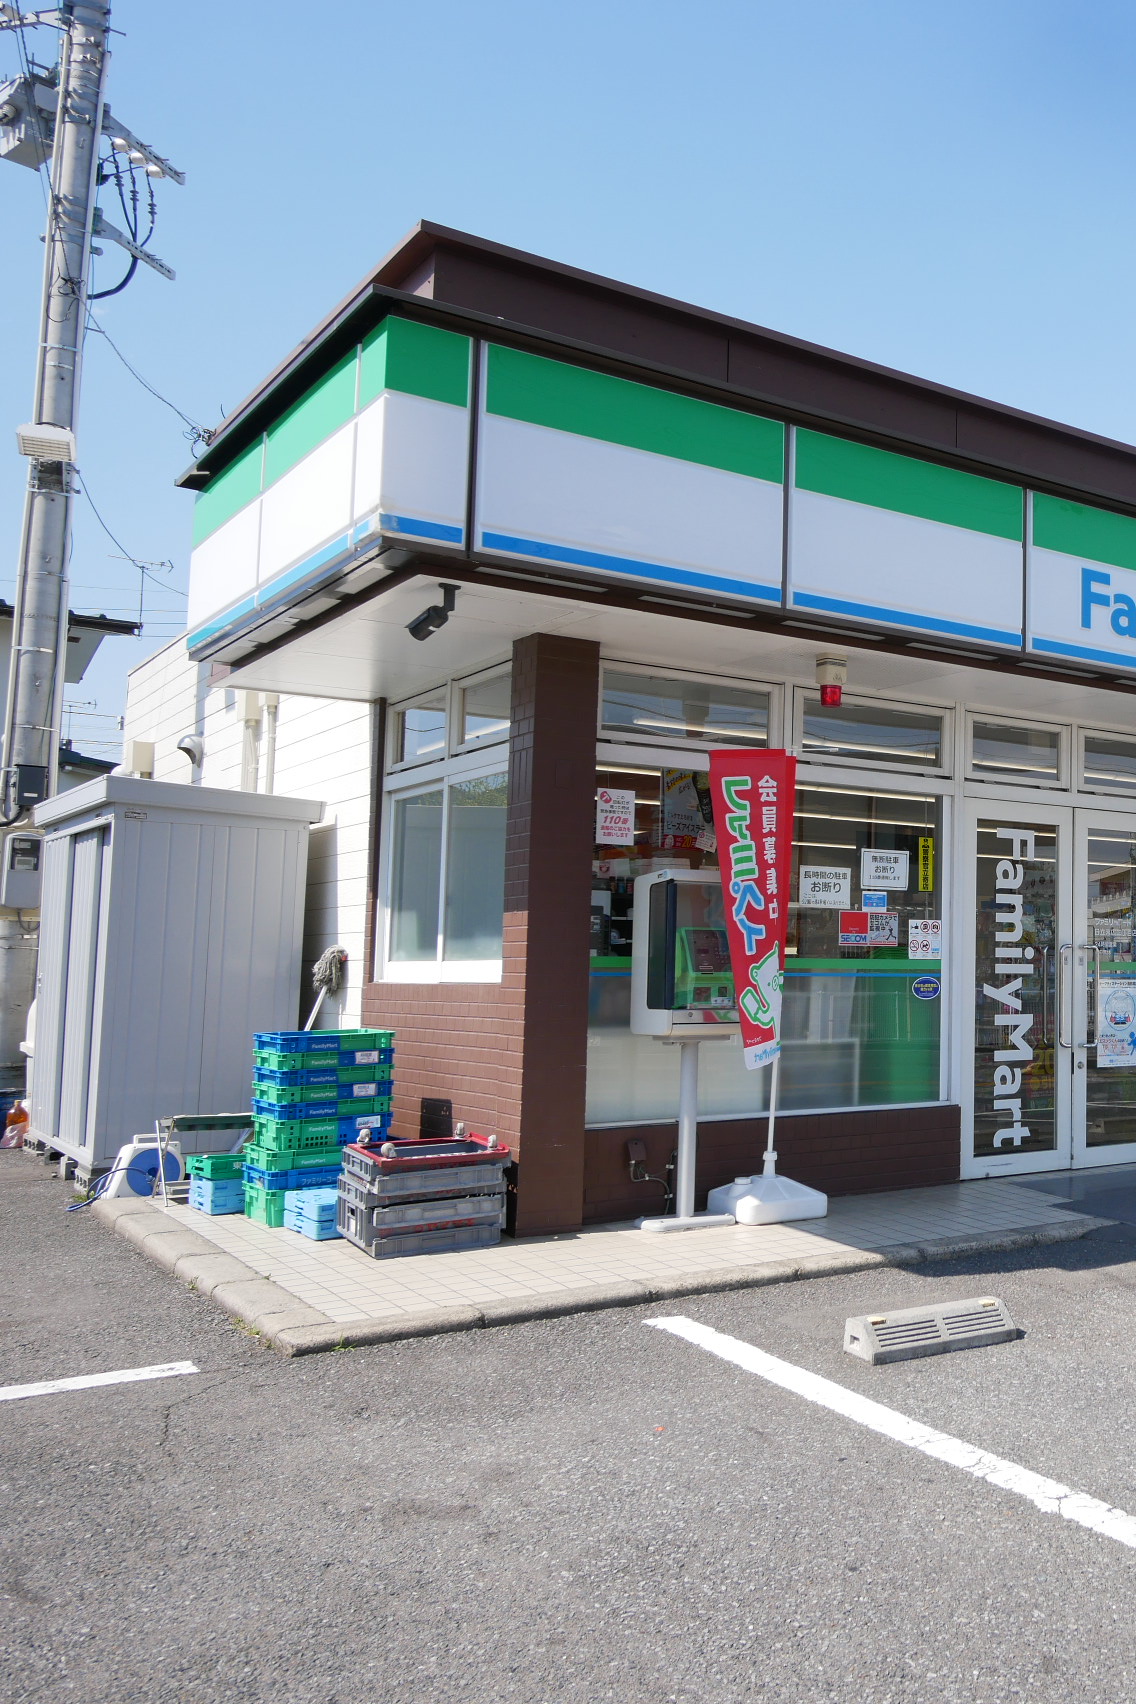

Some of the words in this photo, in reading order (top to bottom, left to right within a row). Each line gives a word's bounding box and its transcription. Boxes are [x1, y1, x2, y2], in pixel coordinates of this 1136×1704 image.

[603, 815, 630, 825] 110番
[803, 870, 848, 880] 長時間の駐車
[875, 865, 896, 875] お断り
[810, 881, 842, 894] お断り
[841, 934, 867, 943] SECOM
[983, 827, 1035, 1149] FamilyMart
